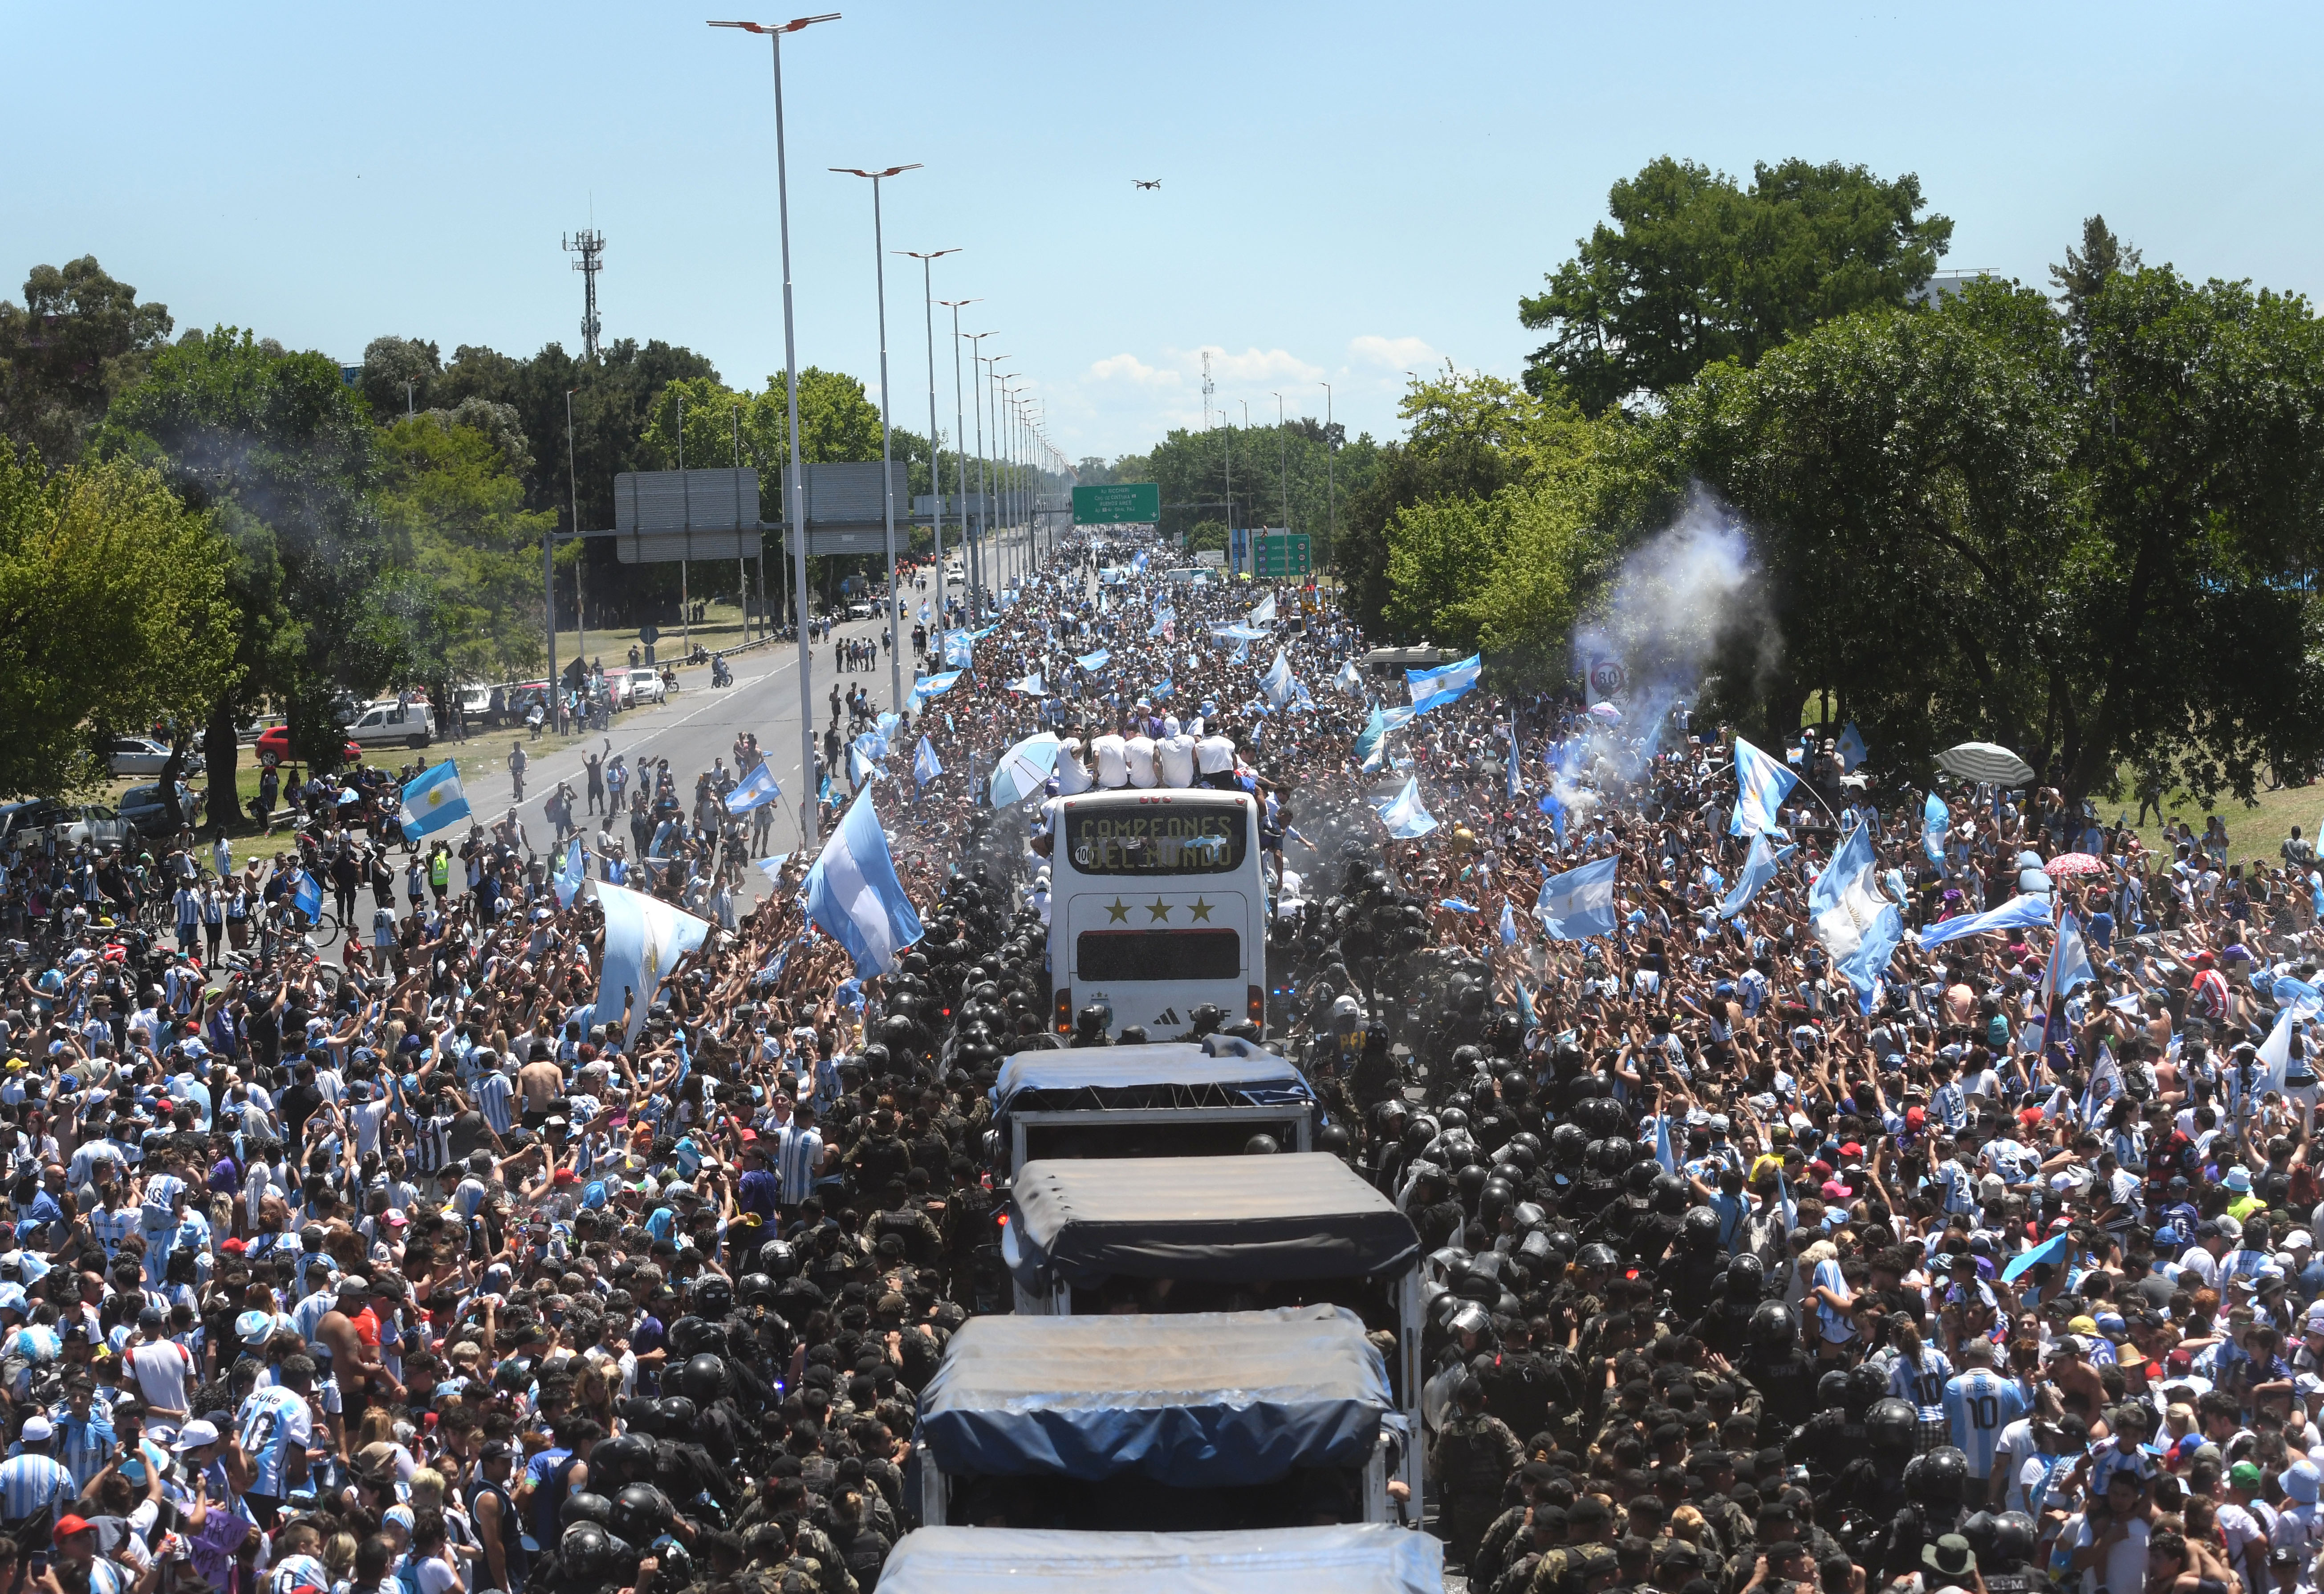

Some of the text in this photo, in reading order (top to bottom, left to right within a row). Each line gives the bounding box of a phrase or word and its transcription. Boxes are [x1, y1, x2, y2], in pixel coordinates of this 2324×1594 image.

[1599, 671, 1617, 684] 80
[1081, 816, 1232, 842] CAMPEONES
[1089, 843, 1232, 869] DEL MUNDO
[1912, 1372, 1942, 1406] 10
[1966, 1383, 1995, 1393] MESSI
[251, 1391, 281, 1405] duke
[1966, 1395, 1998, 1430] 10
[79, 1452, 88, 1464] 10
[2276, 1548, 2287, 1560] S
